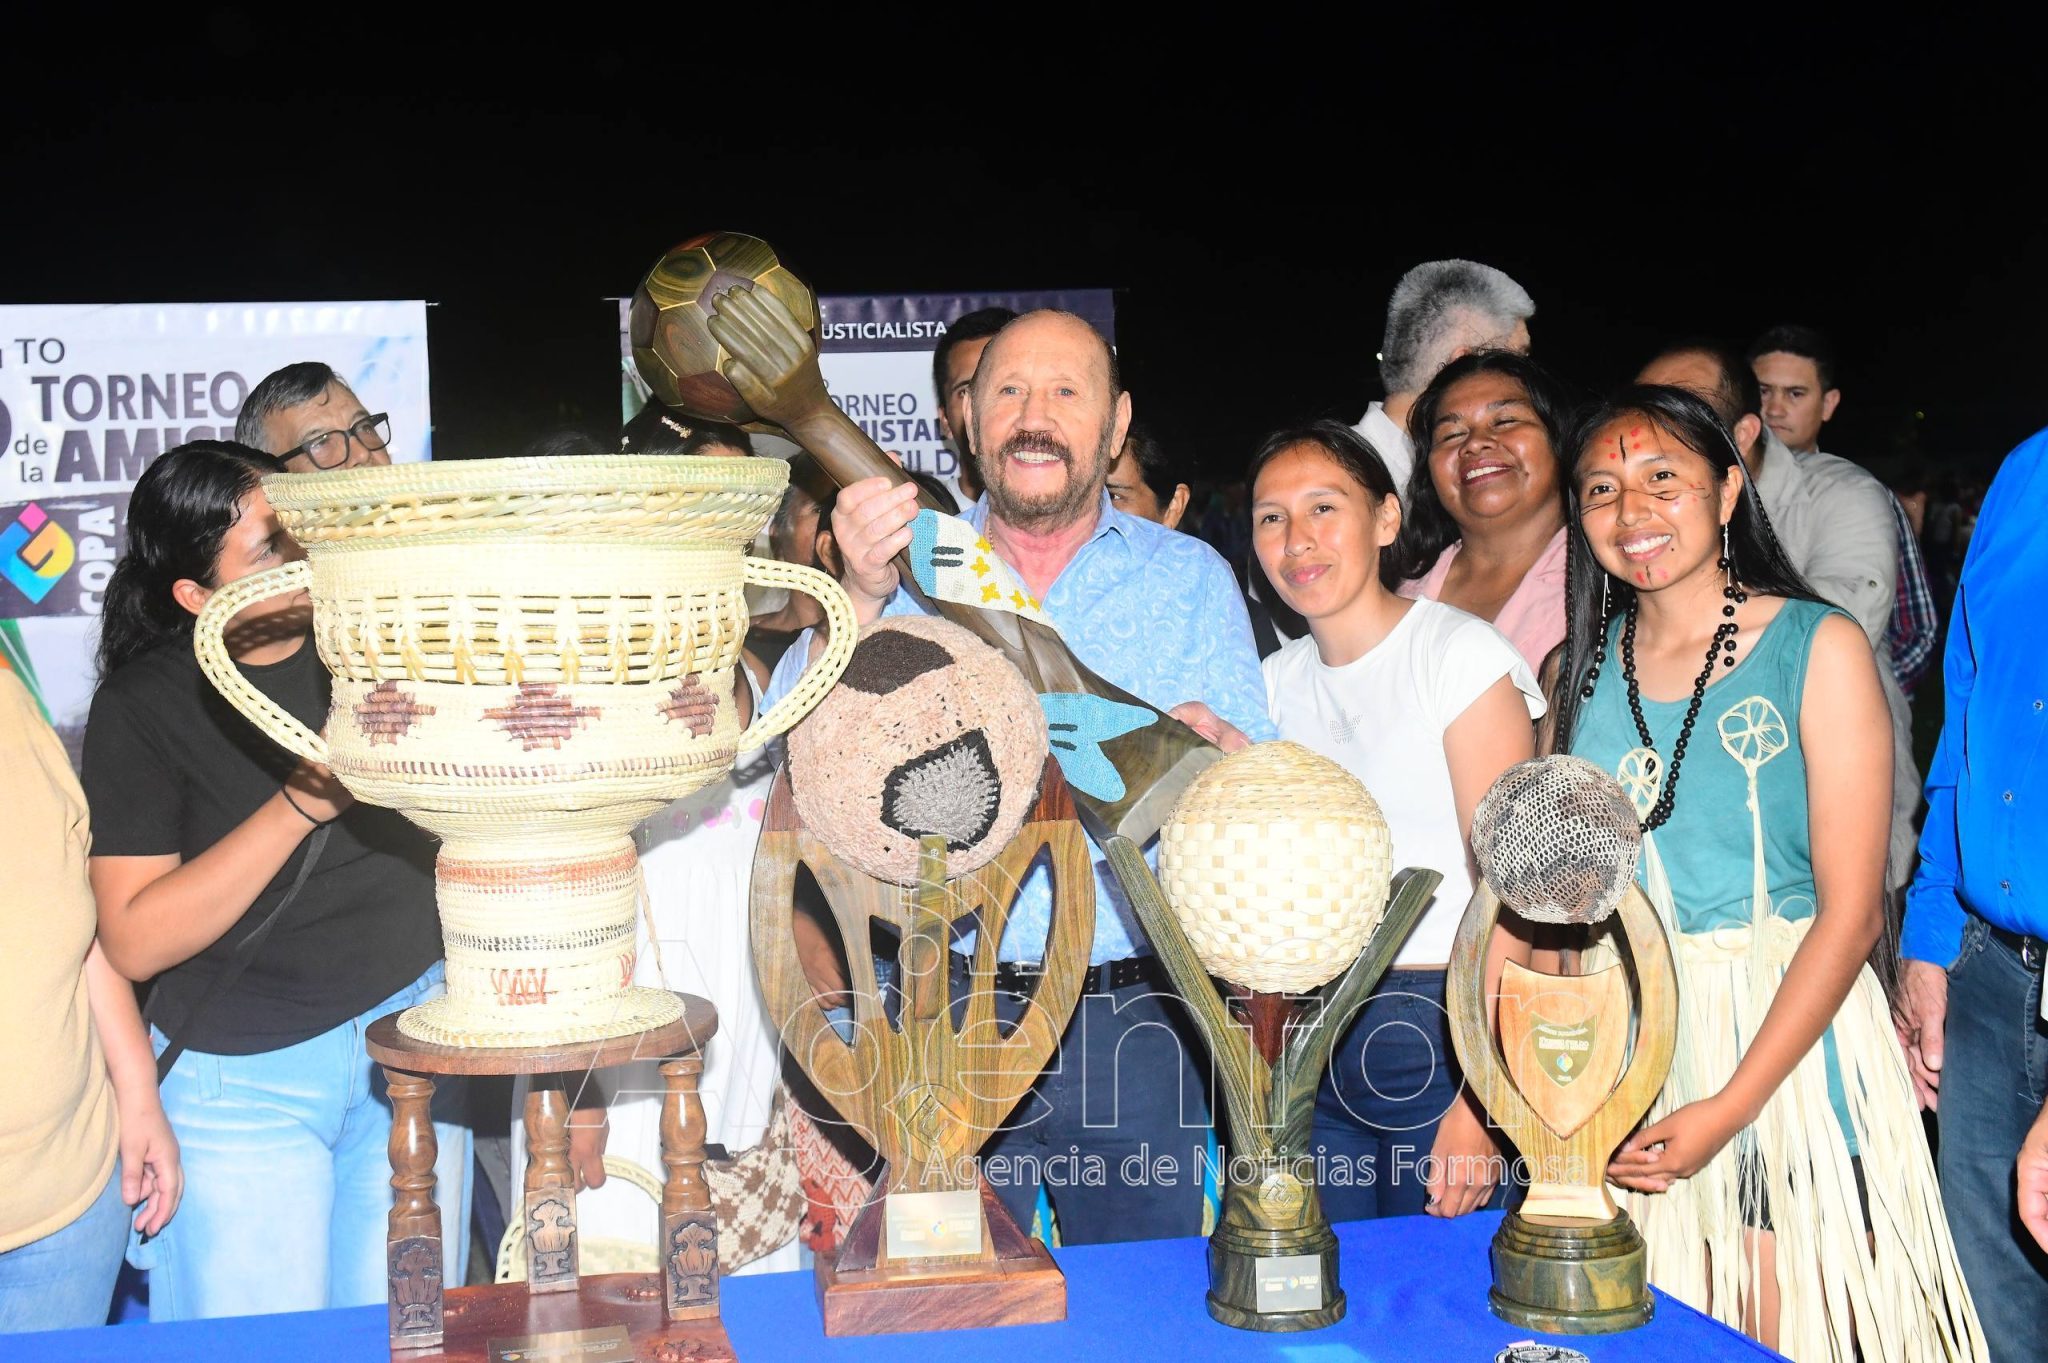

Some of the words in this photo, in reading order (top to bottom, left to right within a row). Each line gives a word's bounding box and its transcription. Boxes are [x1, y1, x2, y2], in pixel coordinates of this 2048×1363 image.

[821, 321, 947, 340] USTICIALISTA
[31, 371, 249, 422] TORNEO
[830, 392, 917, 417] RNEO
[859, 417, 947, 442] ISTA
[14, 433, 48, 455] de
[20, 461, 44, 483] la
